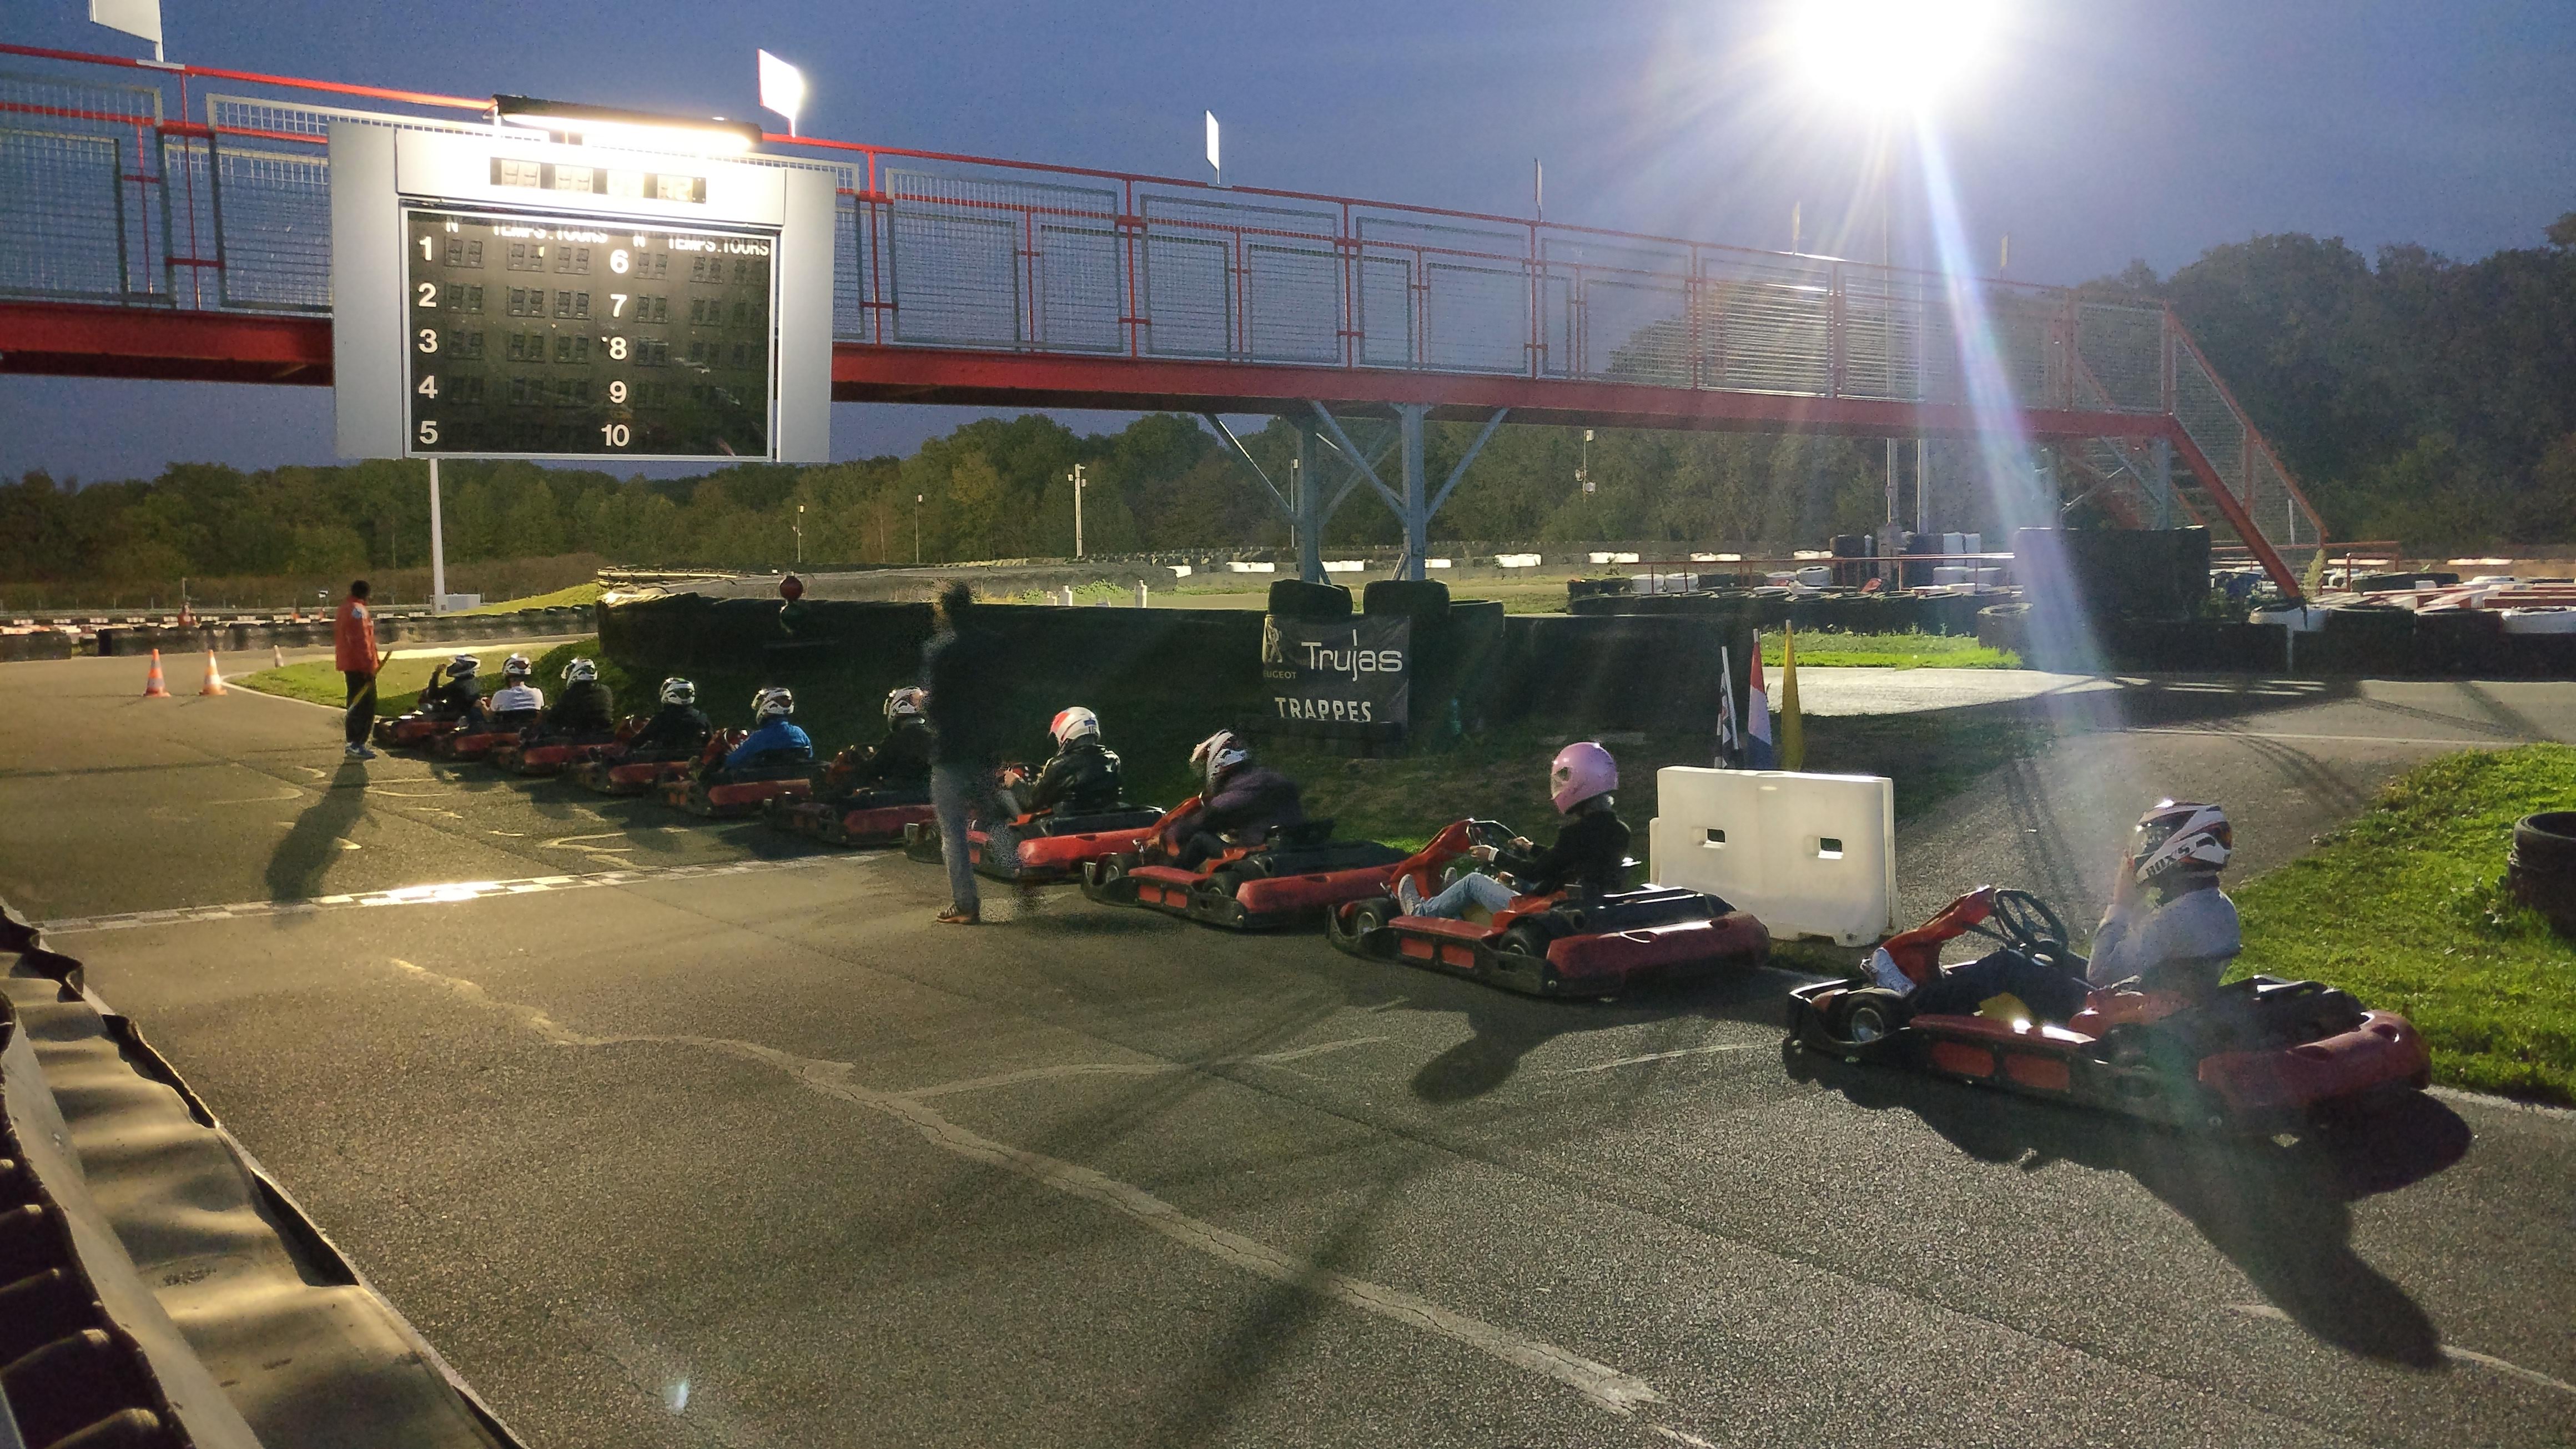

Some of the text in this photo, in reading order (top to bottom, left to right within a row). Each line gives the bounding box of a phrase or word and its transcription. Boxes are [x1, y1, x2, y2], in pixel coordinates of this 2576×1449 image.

[419, 236, 432, 261] 1
[610, 249, 629, 274] 6
[418, 282, 437, 308] 2
[610, 294, 627, 317] 7
[418, 329, 438, 353] 3
[610, 336, 627, 360] 8
[418, 375, 438, 399] 4
[610, 380, 627, 404] 9
[419, 420, 438, 444] 5
[601, 424, 630, 447] 10
[1301, 628, 1403, 682] Trujas
[1263, 670, 1297, 679] EUGEOT
[1275, 697, 1371, 722] TRAPPES
